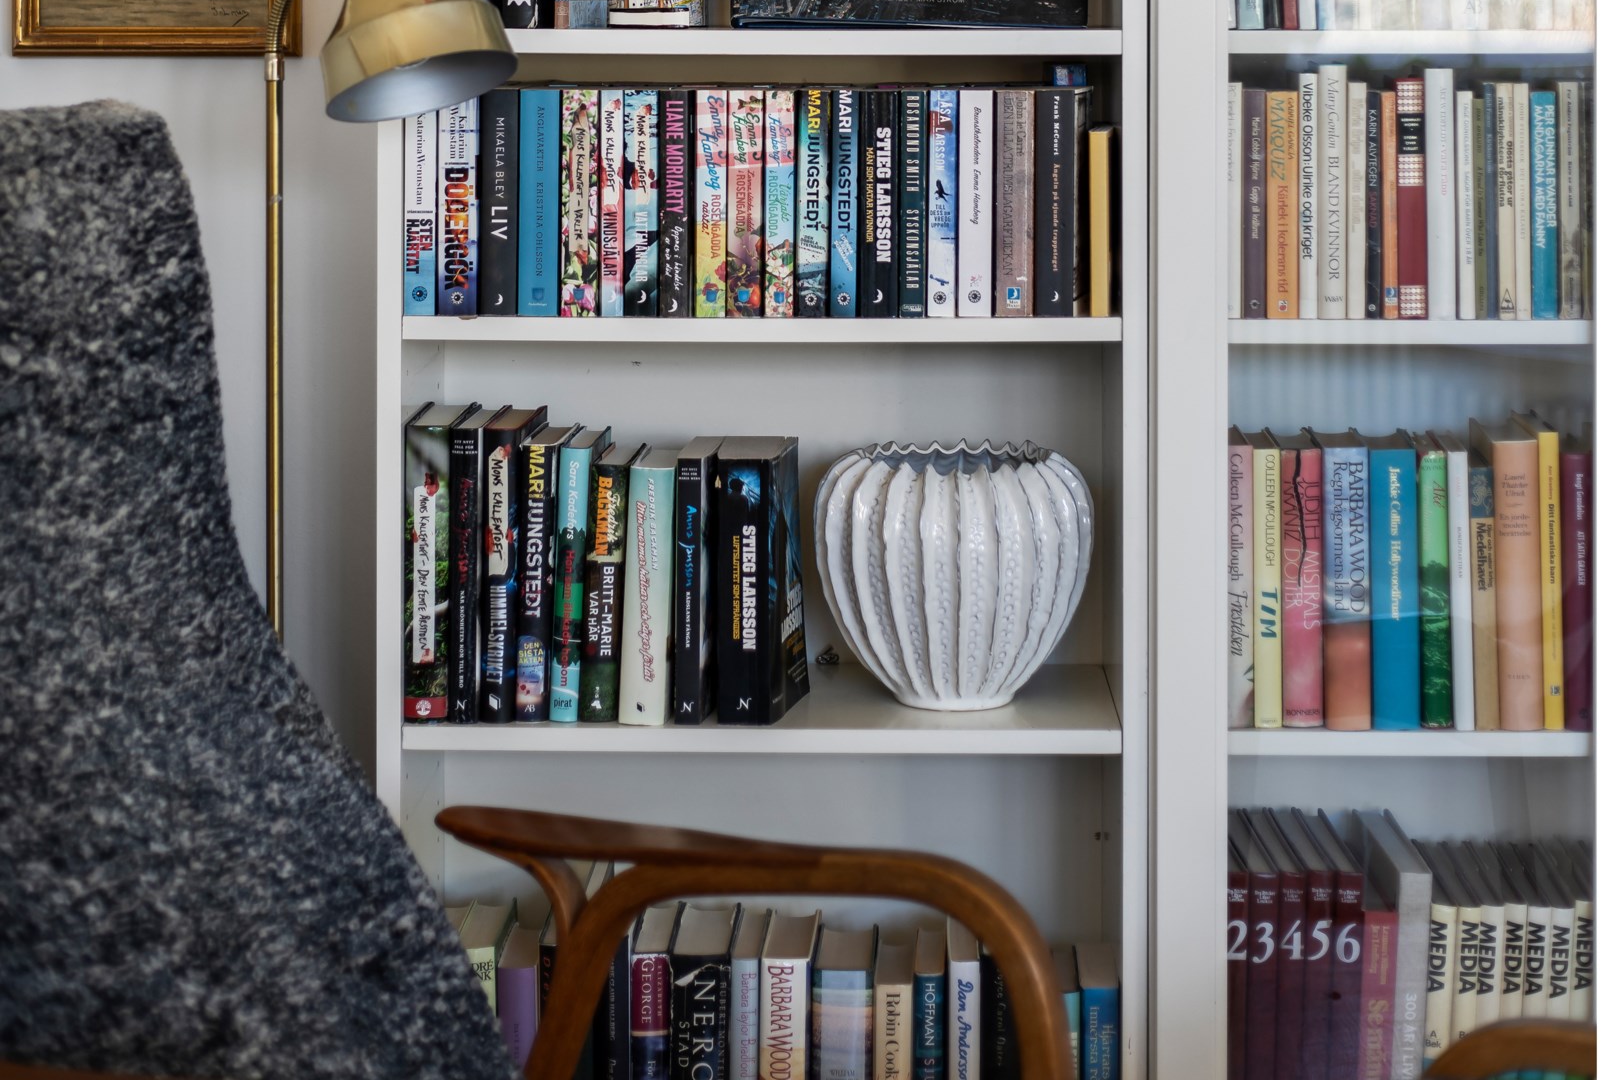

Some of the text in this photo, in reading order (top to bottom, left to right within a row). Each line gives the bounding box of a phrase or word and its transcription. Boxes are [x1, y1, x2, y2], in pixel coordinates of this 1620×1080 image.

[808, 90, 821, 134] MARI
[1302, 83, 1313, 122] Vibeke
[490, 117, 508, 240] MIKAELA BLEY LIV
[666, 100, 684, 213] LIANE MORIARTY
[806, 134, 819, 231] JUNGSTEDT
[1368, 109, 1377, 186] KARIN ALVTEGEN
[1545, 105, 1556, 227] PER GUNNAR EVANDER
[603, 110, 620, 276] MONS KALLENTOFT VINDSJÄLAR
[866, 147, 874, 243] MÄN SOM HATAR KVINNOR
[876, 127, 891, 262] STIEG LARSSON
[1302, 201, 1313, 223] och
[1328, 156, 1340, 281] BLAND KVINNOR
[406, 219, 421, 274] HJÄRTAT
[419, 219, 432, 251] STEN
[444, 168, 474, 290] DÖDERGÖK
[535, 182, 544, 277] KRISTINA OHLSSON
[1300, 225, 1313, 259] kriget
[1265, 454, 1275, 498] COLLEEN
[524, 445, 545, 618] MARI JUNGSTEDT
[1348, 461, 1366, 612] BARBARA WOOD
[1475, 522, 1487, 591] Medelhavet
[588, 591, 601, 641] VAR HÄR
[600, 566, 616, 656] BRITT-MARIE
[742, 525, 757, 650] STIEG LARSSON
[1260, 587, 1279, 638] TIM
[486, 585, 508, 684] HIMMELSKRIKET
[1230, 591, 1249, 657] Frestelsen
[1227, 920, 1248, 961] 2
[1252, 921, 1276, 964] 3
[1280, 920, 1305, 961] 4
[1307, 921, 1333, 961] 5
[1336, 923, 1361, 963] 6
[1428, 919, 1448, 993] MEDIA
[1459, 920, 1479, 994] MEDIA
[641, 961, 656, 1024] GEORGE
[924, 983, 936, 1046] HOFFMAN
[678, 1021, 690, 1068] STAD
[884, 993, 902, 1079] Robin Cook
